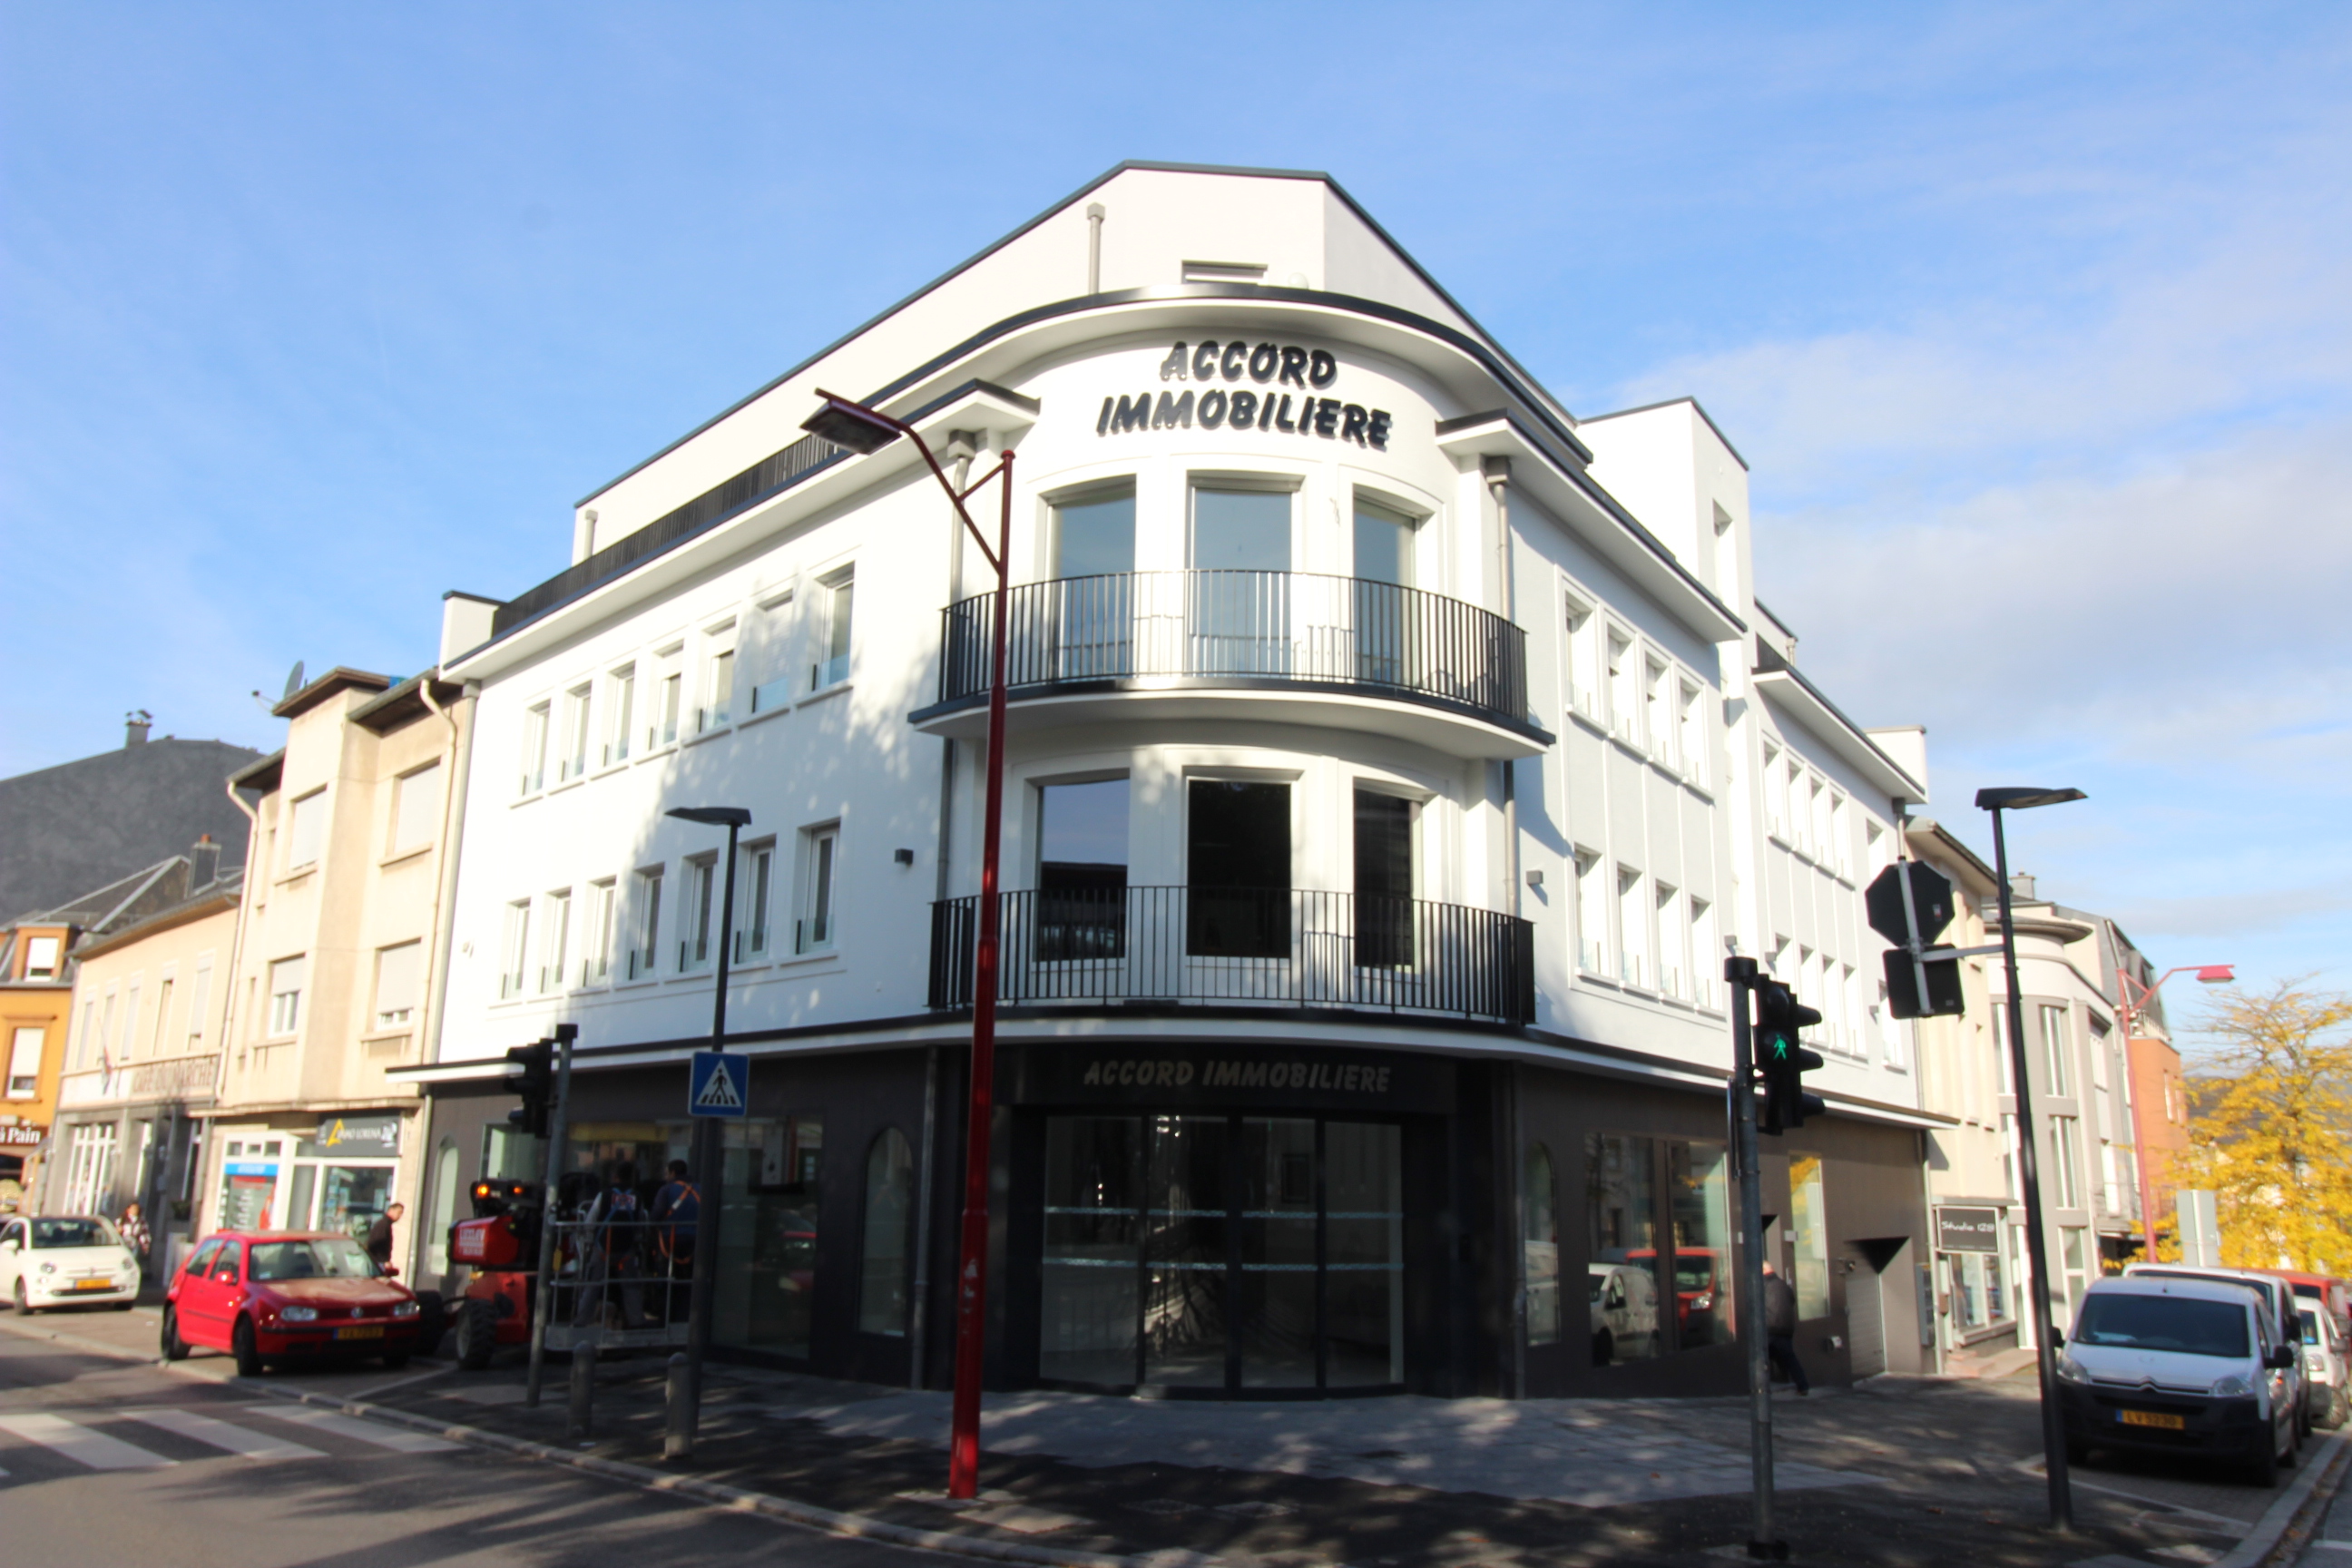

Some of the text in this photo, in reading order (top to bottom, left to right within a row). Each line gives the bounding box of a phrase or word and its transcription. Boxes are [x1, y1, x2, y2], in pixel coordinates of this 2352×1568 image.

[1160, 340, 1337, 389] ACCORD
[1095, 388, 1391, 452] IMMOBILIERE
[1083, 1060, 1391, 1093] ACCORD IMMOBILIERE
[7, 1126, 41, 1143] Pain
[1941, 1220, 1975, 1231] Studio
